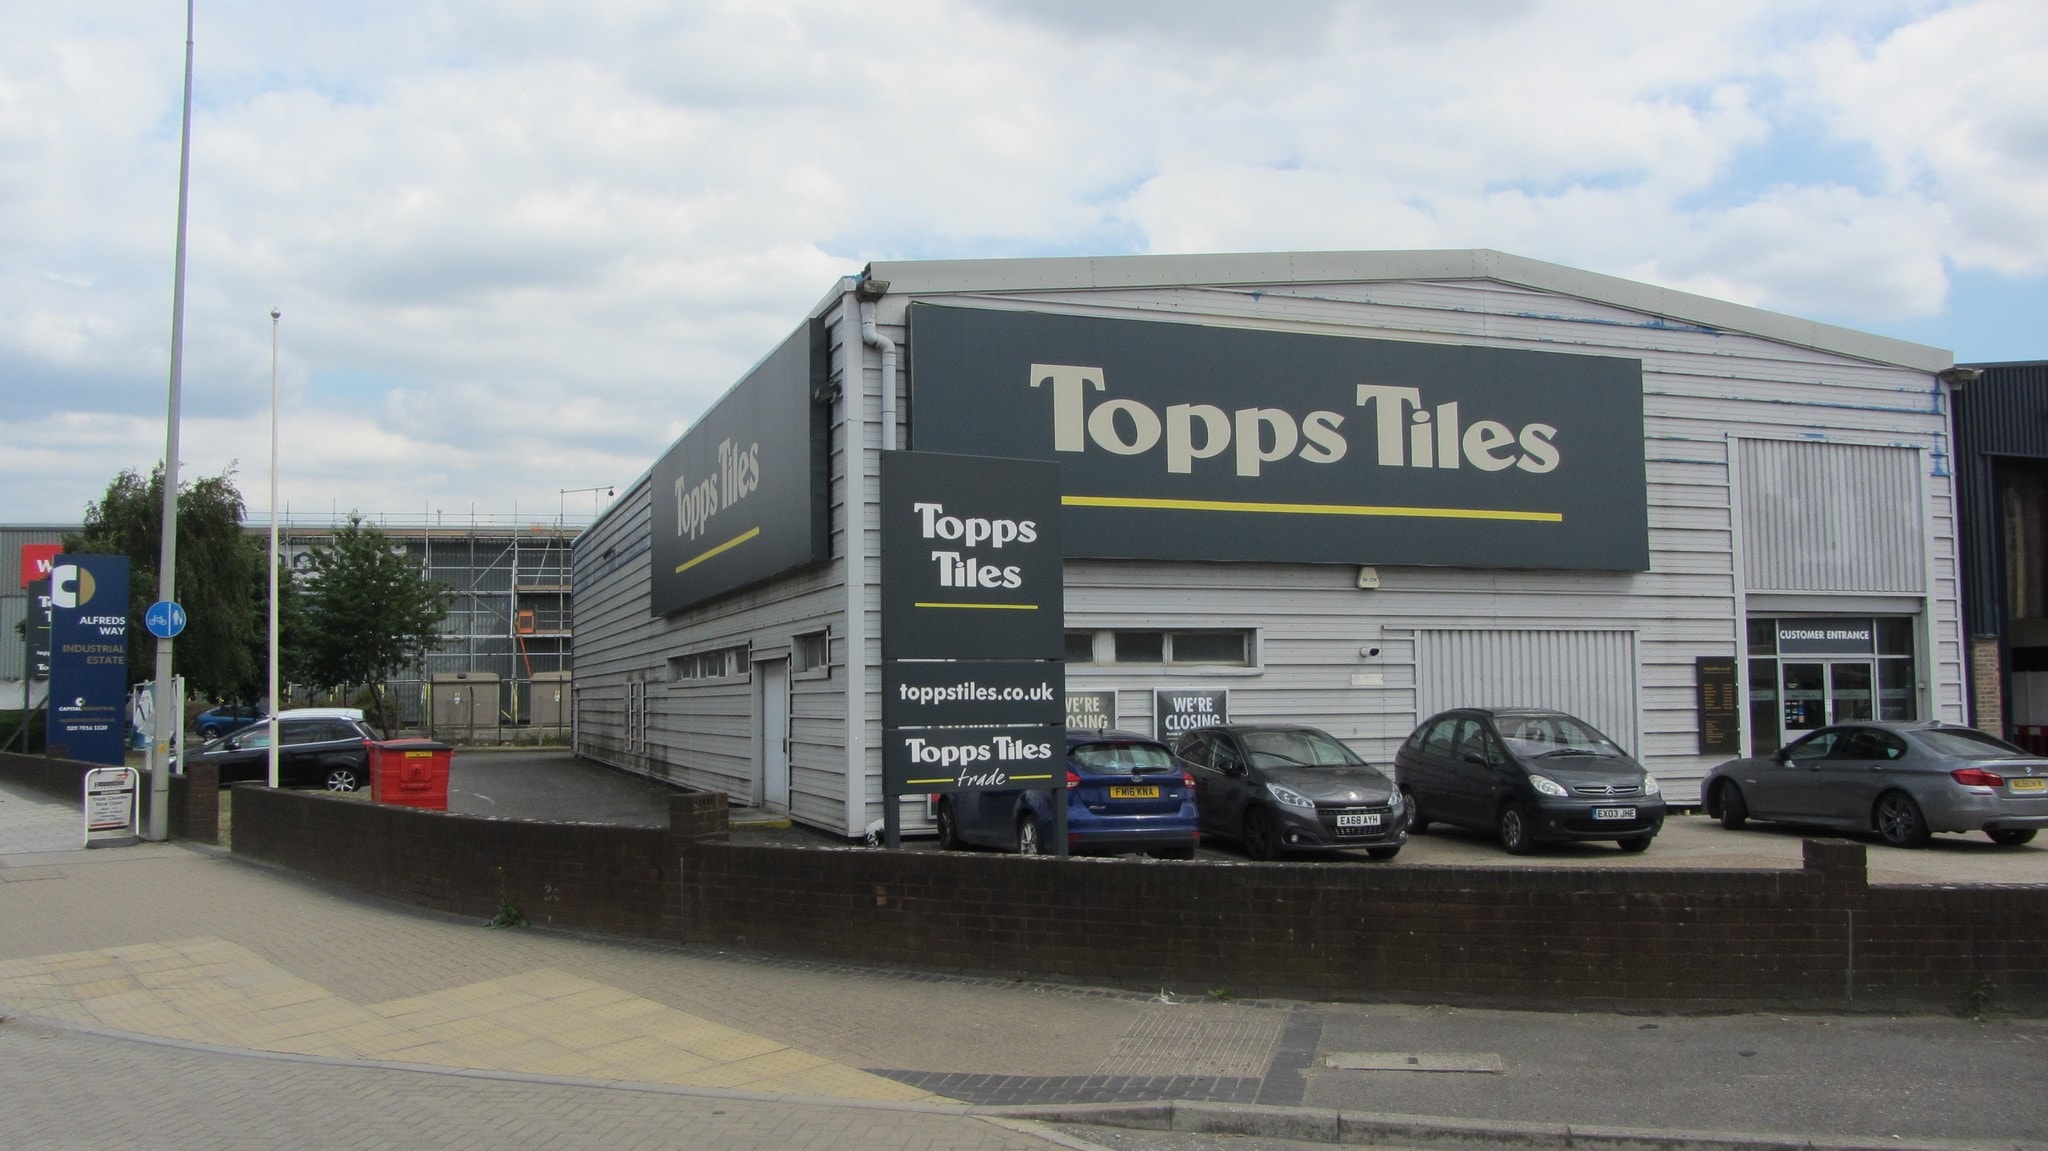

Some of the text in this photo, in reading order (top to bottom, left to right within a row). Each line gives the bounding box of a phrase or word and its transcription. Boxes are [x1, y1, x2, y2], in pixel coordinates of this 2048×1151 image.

[1030, 363, 1560, 477] Topps Tiles
[675, 437, 760, 541] Topps Tiles
[913, 502, 1038, 548] Topps
[931, 550, 1022, 589] Tiles
[79, 616, 126, 625] ALFREDS
[99, 627, 125, 635] WAY
[1780, 630, 1869, 639] CUSTOMER ENTRANCE
[62, 644, 125, 653] INDUSTRIAL
[86, 656, 125, 664] ESTATE
[900, 681, 1054, 705] toppstiles.co.uk
[1172, 697, 1213, 713] WE'RE
[1065, 714, 1108, 729] OSING
[1165, 714, 1221, 730] CLOSING
[905, 736, 1052, 767] Topps Tiles
[957, 767, 1006, 787] trade
[1137, 787, 1154, 796] KNA
[1340, 815, 1378, 825] EA68 AYH
[1598, 809, 1635, 818] EX03 JHE
